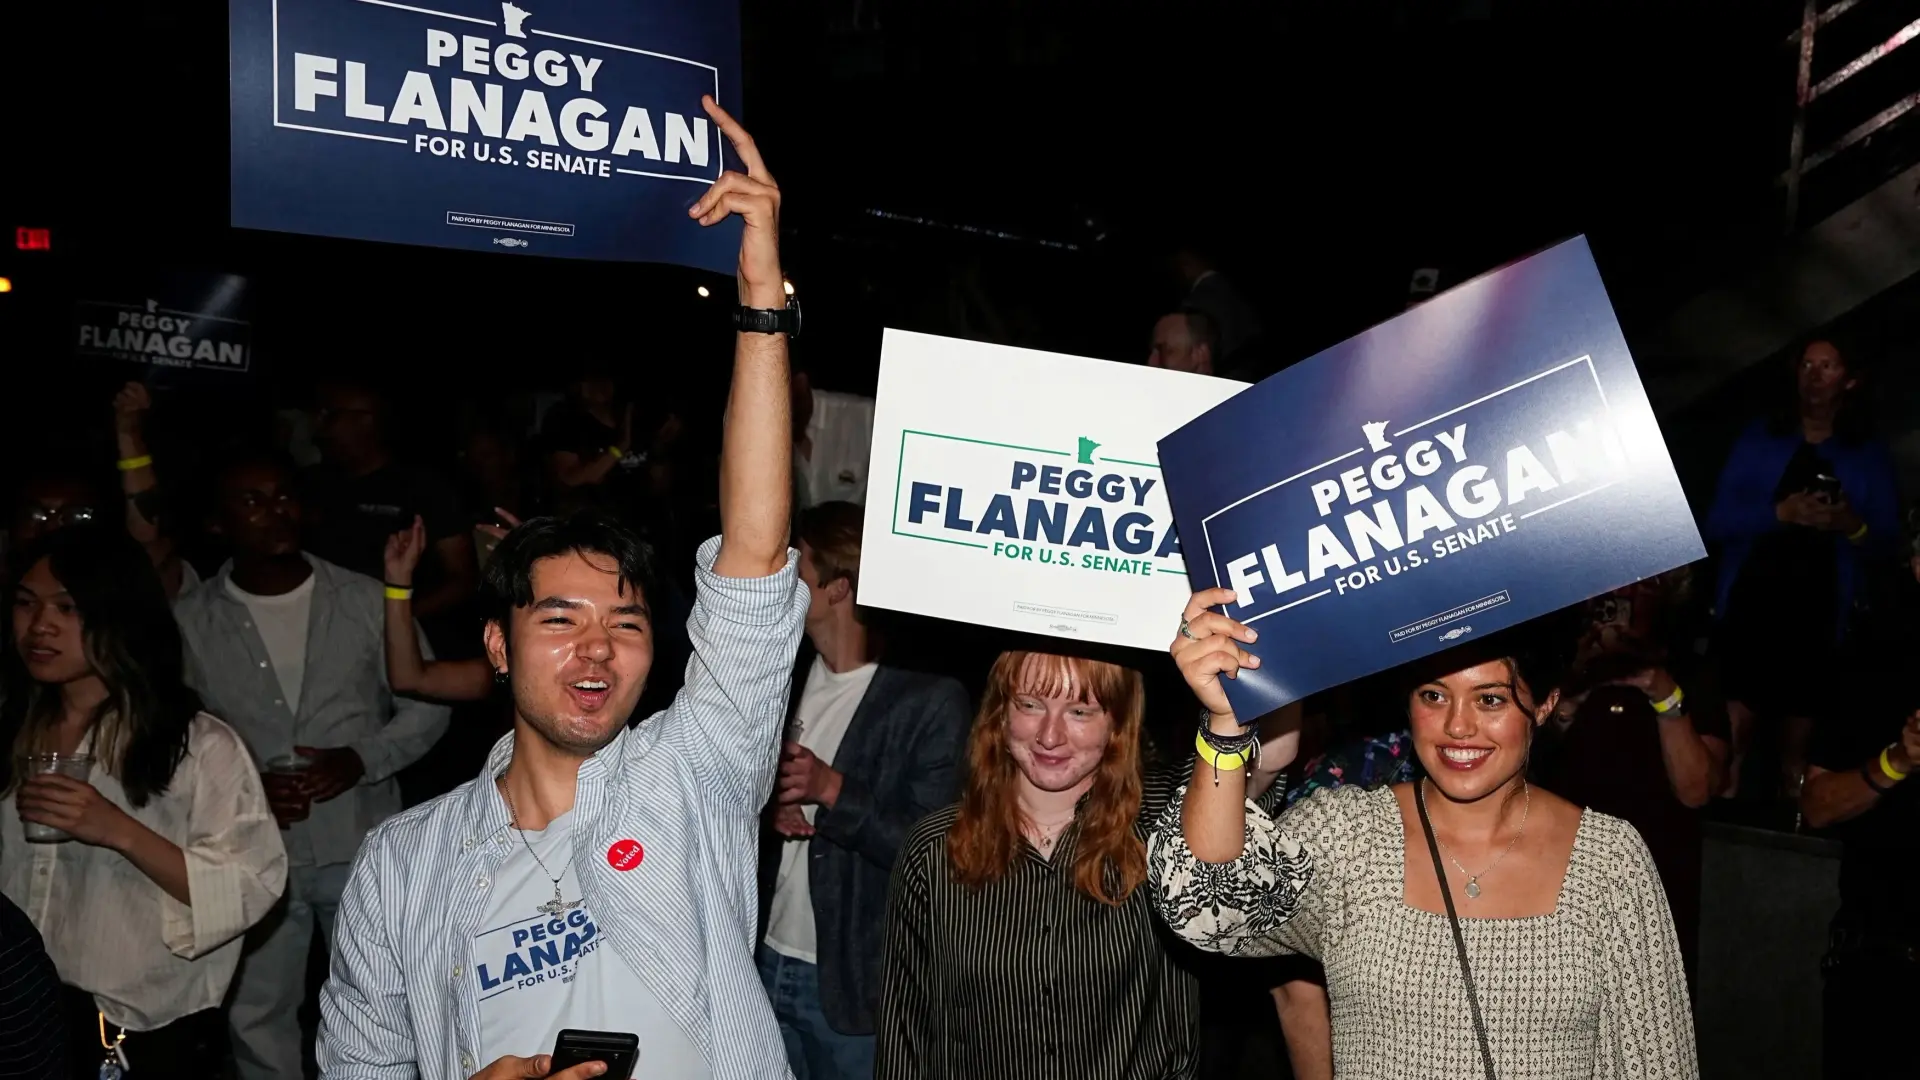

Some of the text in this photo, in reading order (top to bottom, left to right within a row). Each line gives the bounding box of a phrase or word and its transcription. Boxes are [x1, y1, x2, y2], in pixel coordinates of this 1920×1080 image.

[427, 28, 603, 92] PEGGY
[294, 52, 710, 167] FLANAGAN
[415, 135, 611, 177] FOR U.S. SENATE
[501, 221, 531, 229] FLANAGAN
[540, 224, 570, 233] MINNESOTA
[117, 310, 191, 334] PEGGY
[78, 324, 243, 365] FLANAGAN
[1010, 460, 1157, 506] PEGGY
[1310, 423, 1468, 516] PEGGY
[907, 481, 1182, 559] FLANAGA
[993, 542, 1153, 577] FOR U.S. SENATE
[1335, 513, 1517, 595] FOR U.S. SENATE
[1394, 630, 1406, 638] PAID
[1405, 626, 1416, 634] FOR
[1422, 618, 1439, 629] PEGGY
[1438, 609, 1466, 623] FLANAGAN
[1475, 594, 1506, 610] MINNESOTA
[615, 845, 640, 867] Voted
[616, 847, 625, 855] I
[512, 910, 588, 948] PEGG
[518, 973, 545, 990] FOR
[547, 965, 572, 979] U.S.
